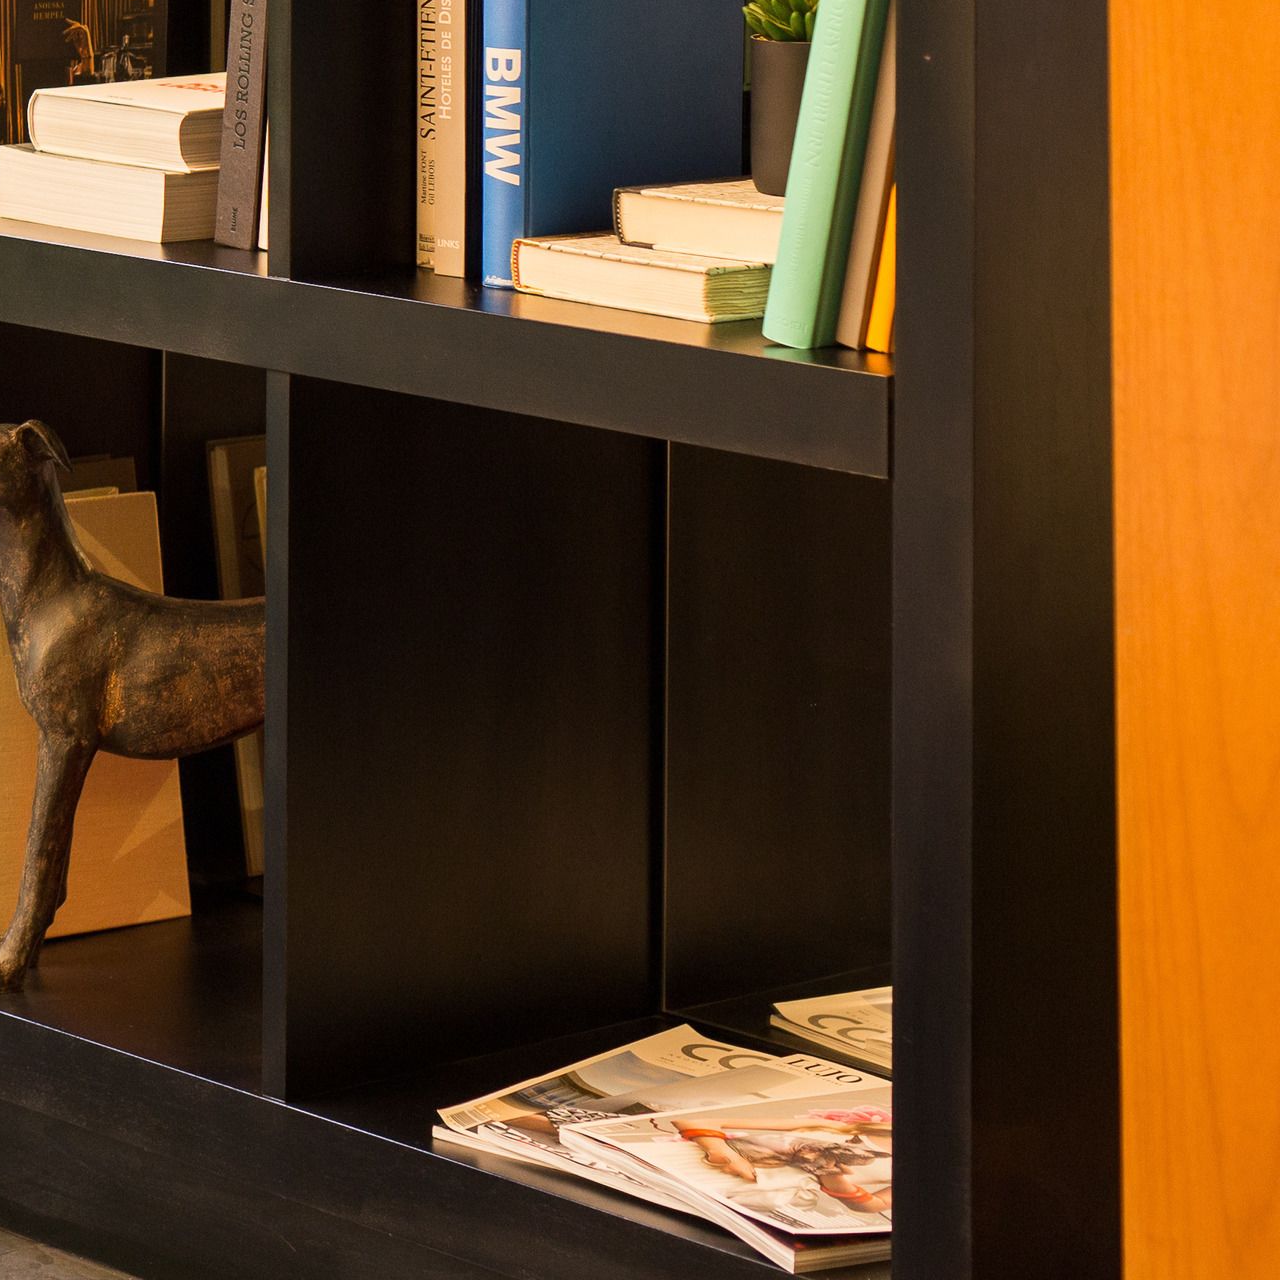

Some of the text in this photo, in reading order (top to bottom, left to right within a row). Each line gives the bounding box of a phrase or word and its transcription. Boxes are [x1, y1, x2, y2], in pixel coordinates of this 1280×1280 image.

[236, 13, 253, 104] ROLLING
[440, 32, 452, 48] DE
[439, 56, 452, 120] HOTELES
[233, 109, 247, 151] LOS
[484, 46, 521, 186] BMW
[804, 59, 836, 169] HEPBURN
[229, 207, 238, 232] BLUME
[437, 238, 460, 249] LINKS
[787, 1058, 862, 1084] LUJO
